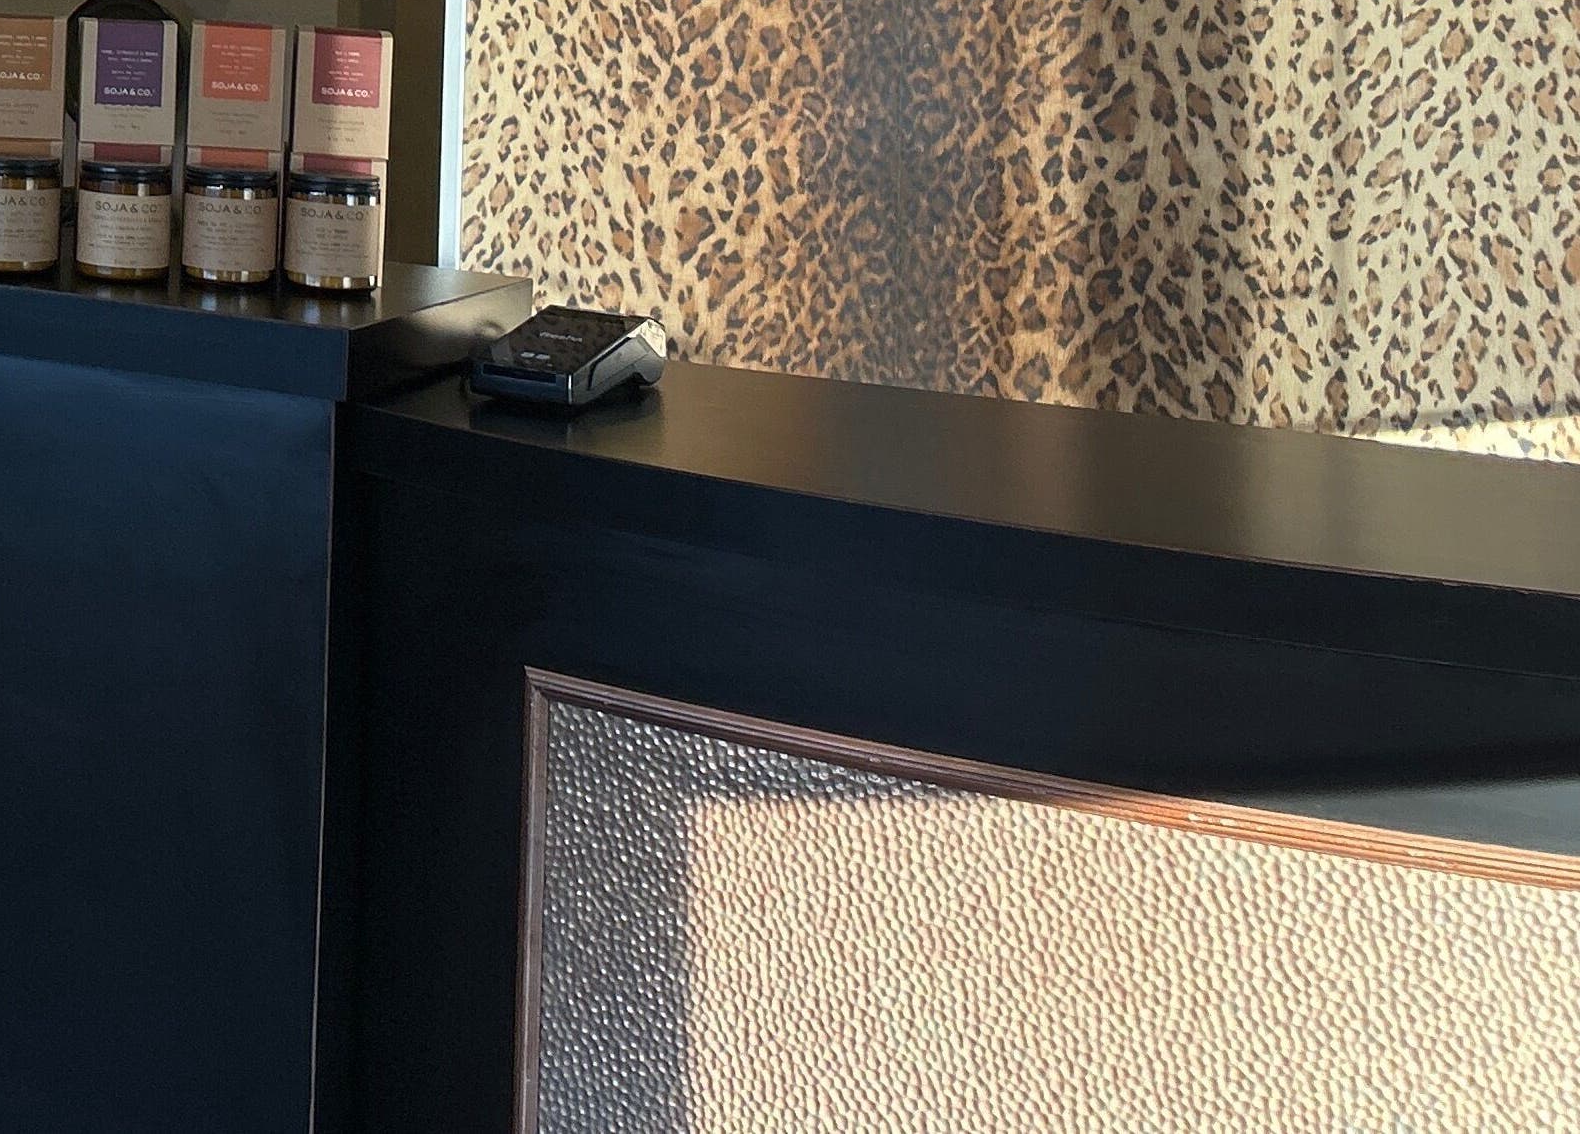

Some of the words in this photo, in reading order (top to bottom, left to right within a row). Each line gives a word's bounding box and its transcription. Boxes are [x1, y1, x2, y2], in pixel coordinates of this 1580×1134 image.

[103, 86, 128, 95] SOJA
[129, 87, 136, 96] &
[211, 81, 236, 90] SOJA
[321, 86, 346, 96] SOJA
[346, 88, 354, 97] &
[18, 196, 27, 206] &
[94, 200, 128, 213] SOJA
[129, 202, 139, 213] &
[197, 201, 231, 214] SOJA
[233, 204, 242, 215] &
[300, 206, 333, 220] SOJA
[335, 209, 344, 220] &
